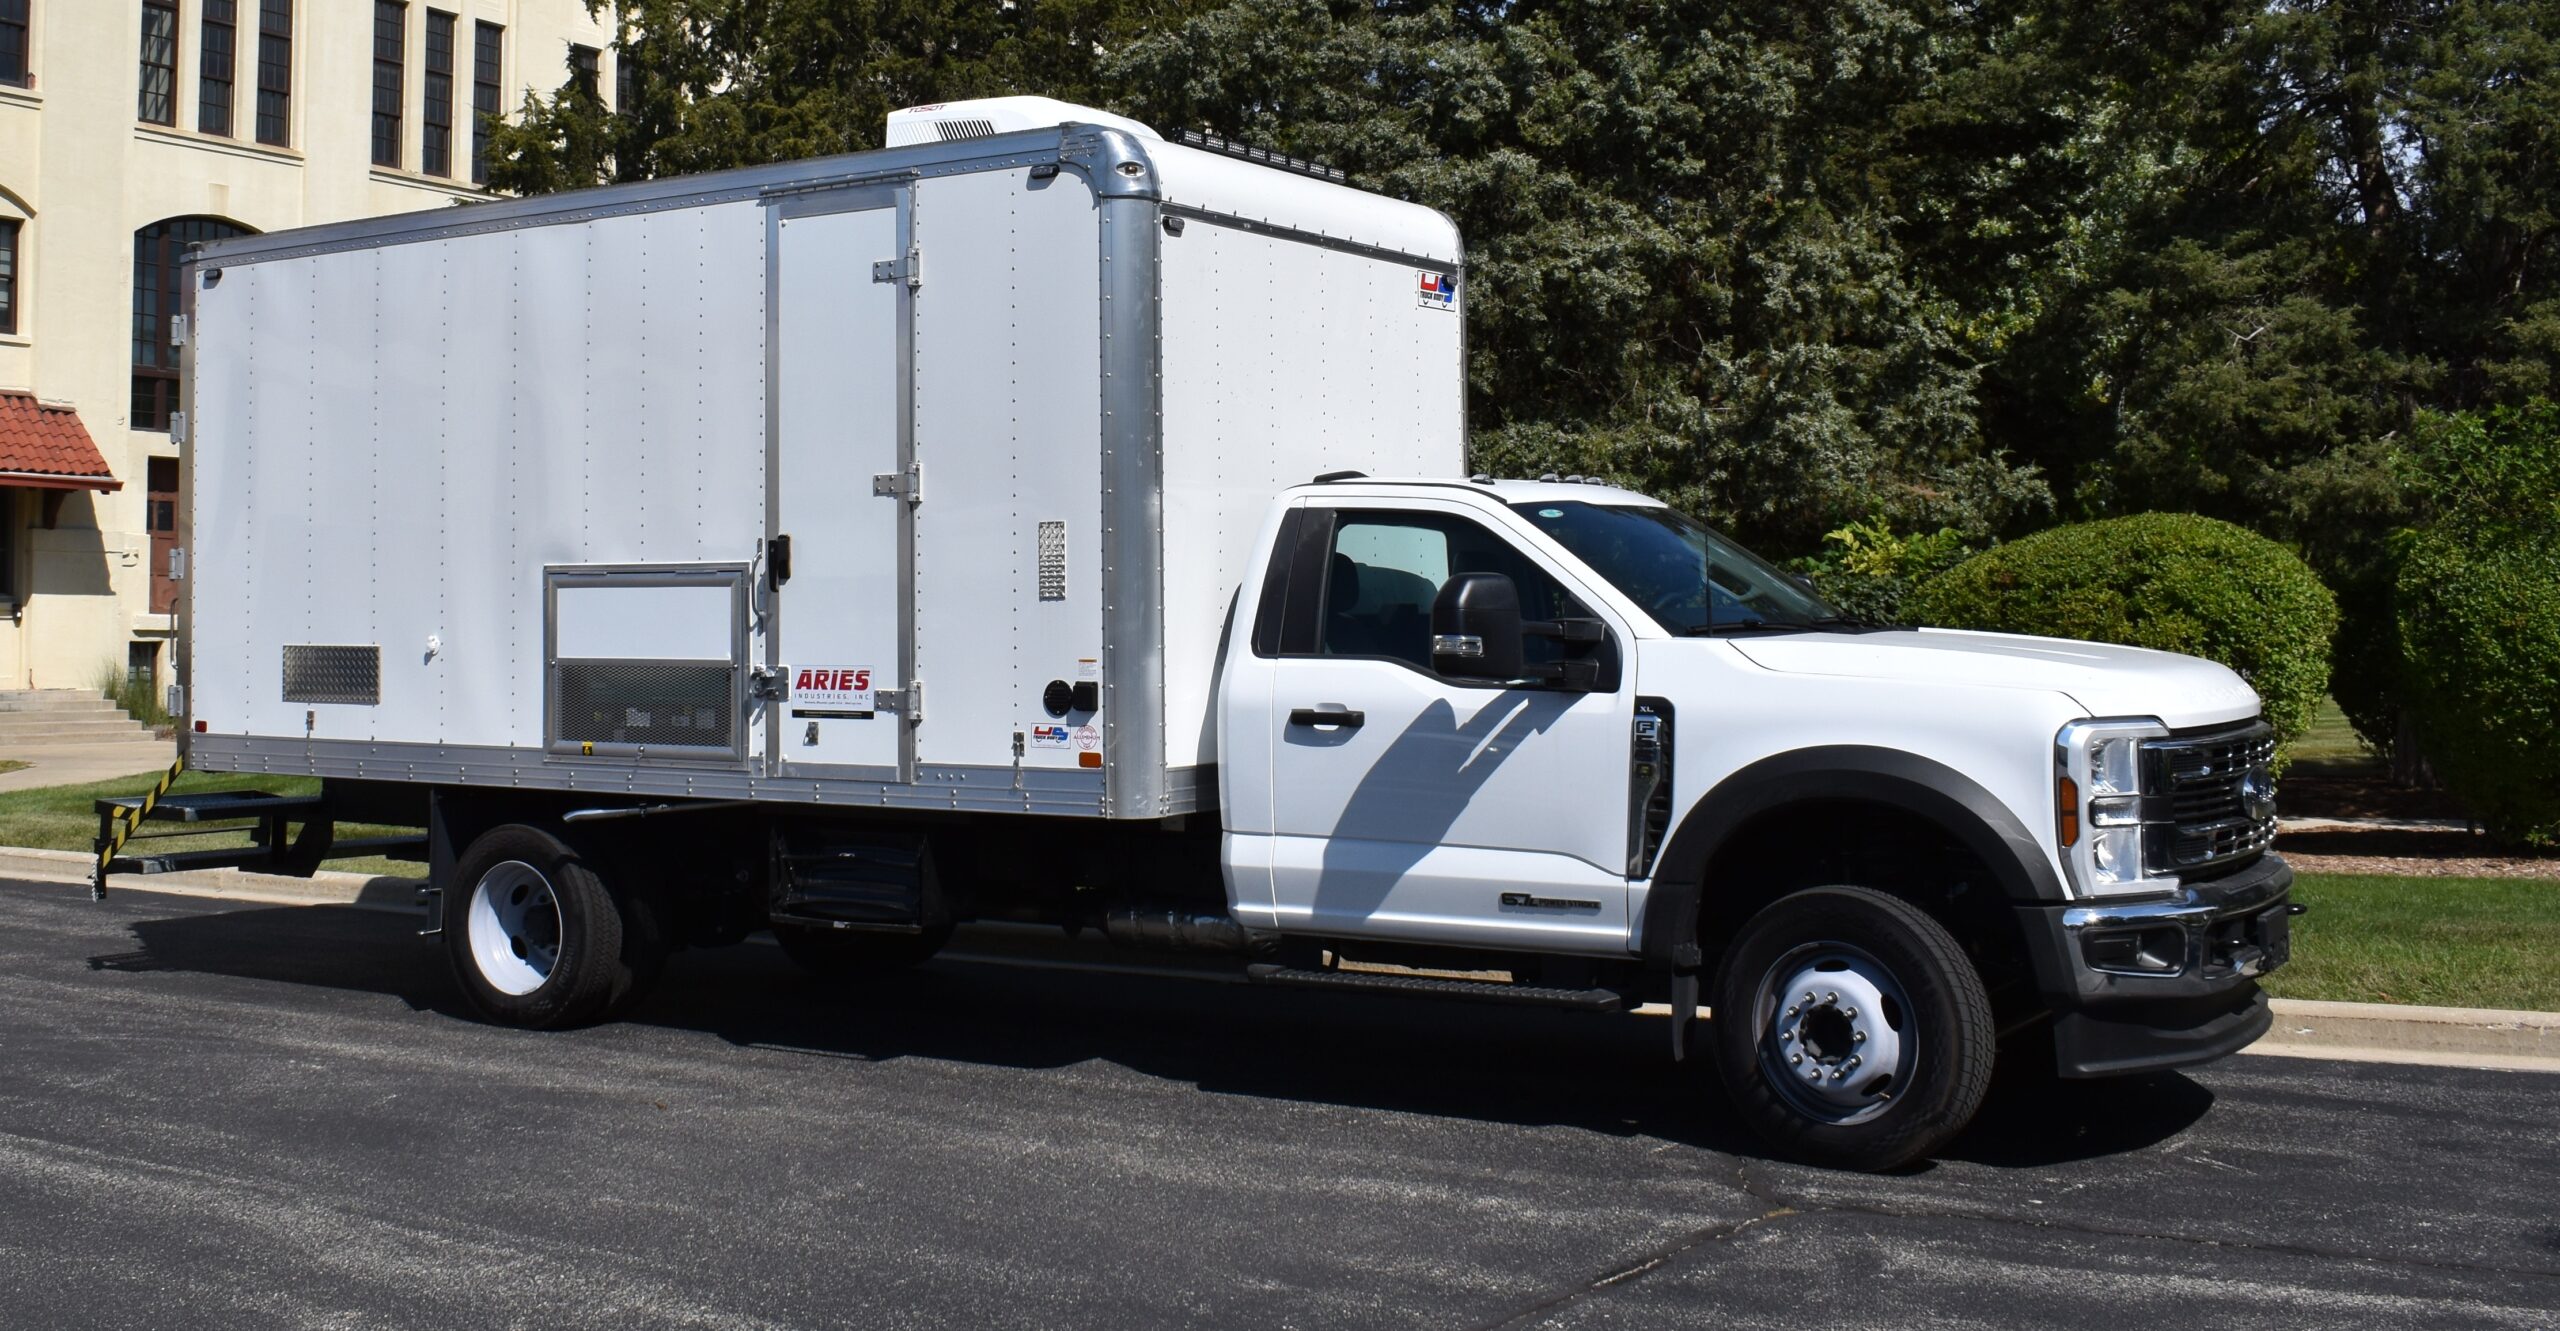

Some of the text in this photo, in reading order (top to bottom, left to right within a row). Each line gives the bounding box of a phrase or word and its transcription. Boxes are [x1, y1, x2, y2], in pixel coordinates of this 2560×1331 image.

[908, 104, 947, 114] TOSOT
[1420, 290, 1433, 299] TRUCK
[795, 669, 871, 691] ARIES
[854, 693, 872, 701] INC.
[1639, 705, 1654, 713] XL
[1033, 726, 1069, 741] US
